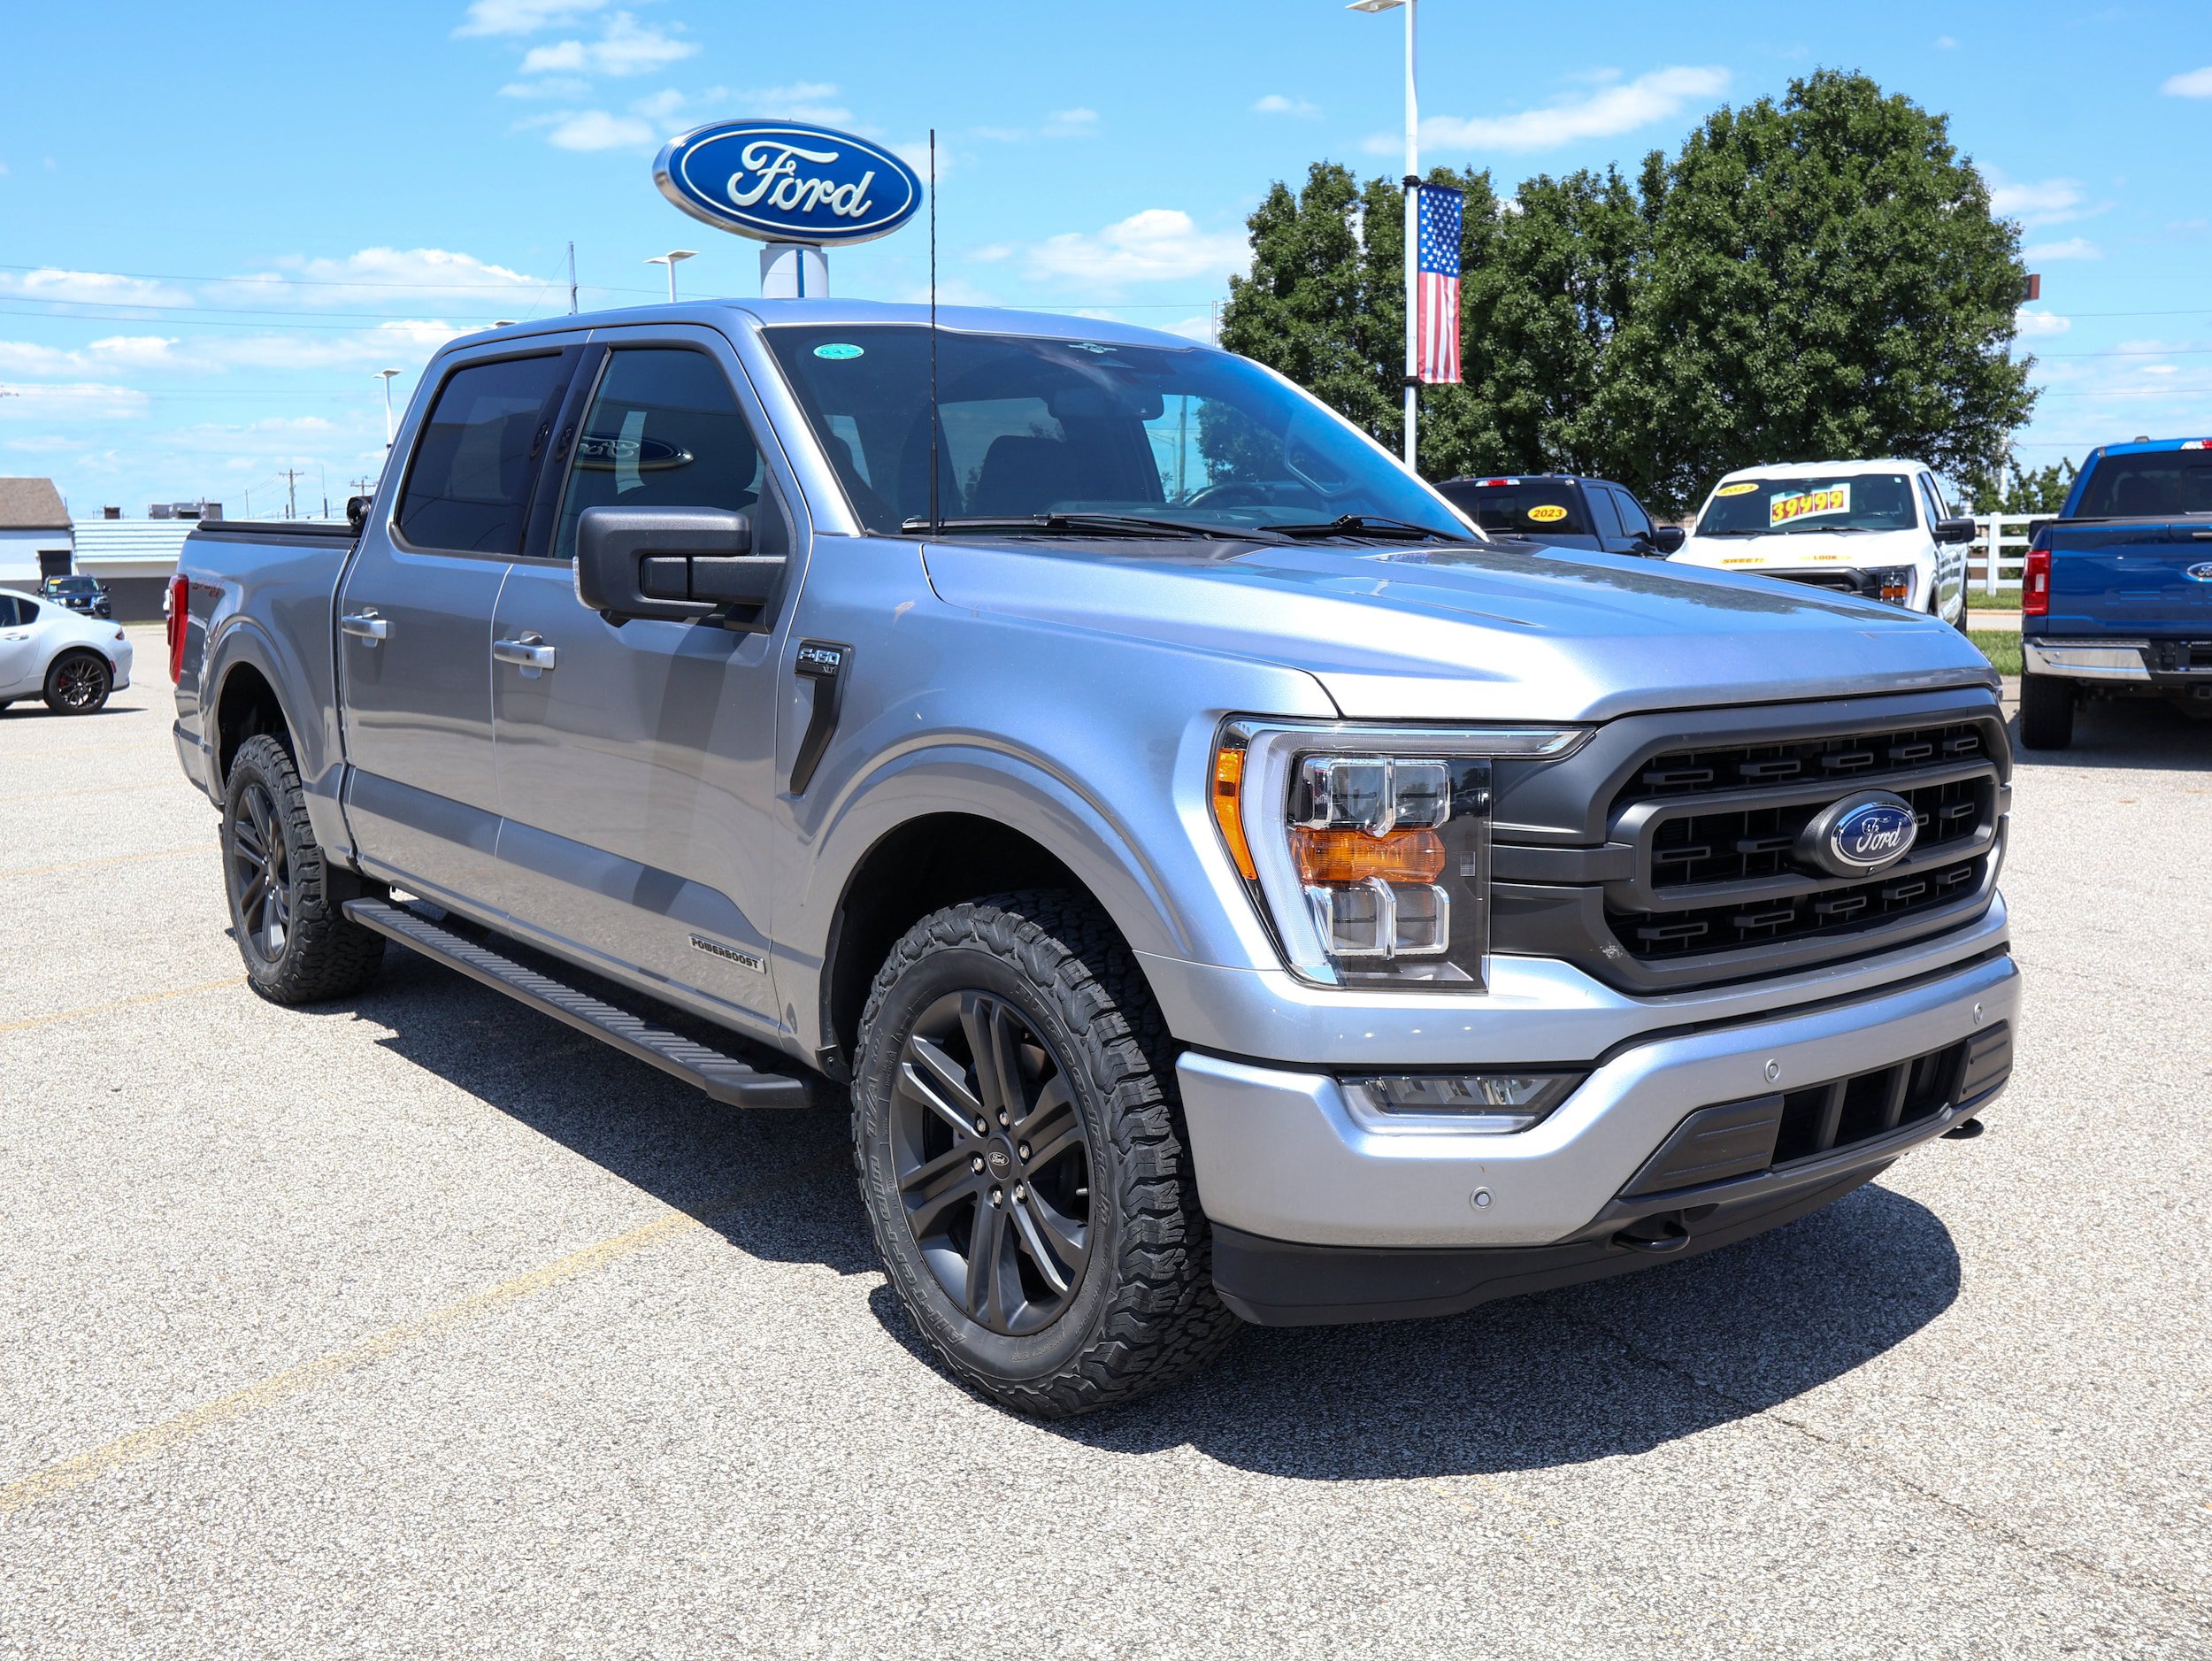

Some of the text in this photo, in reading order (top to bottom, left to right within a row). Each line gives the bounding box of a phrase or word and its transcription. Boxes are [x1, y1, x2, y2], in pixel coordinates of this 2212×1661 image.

[726, 141, 875, 218] Ford
[1532, 509, 1563, 519] 2023
[1772, 491, 1843, 522] 39999
[797, 648, 841, 665] F-150
[1856, 816, 1903, 853] Ford
[691, 937, 758, 969] POWERBOOST
[991, 1153, 1008, 1165] Ford
